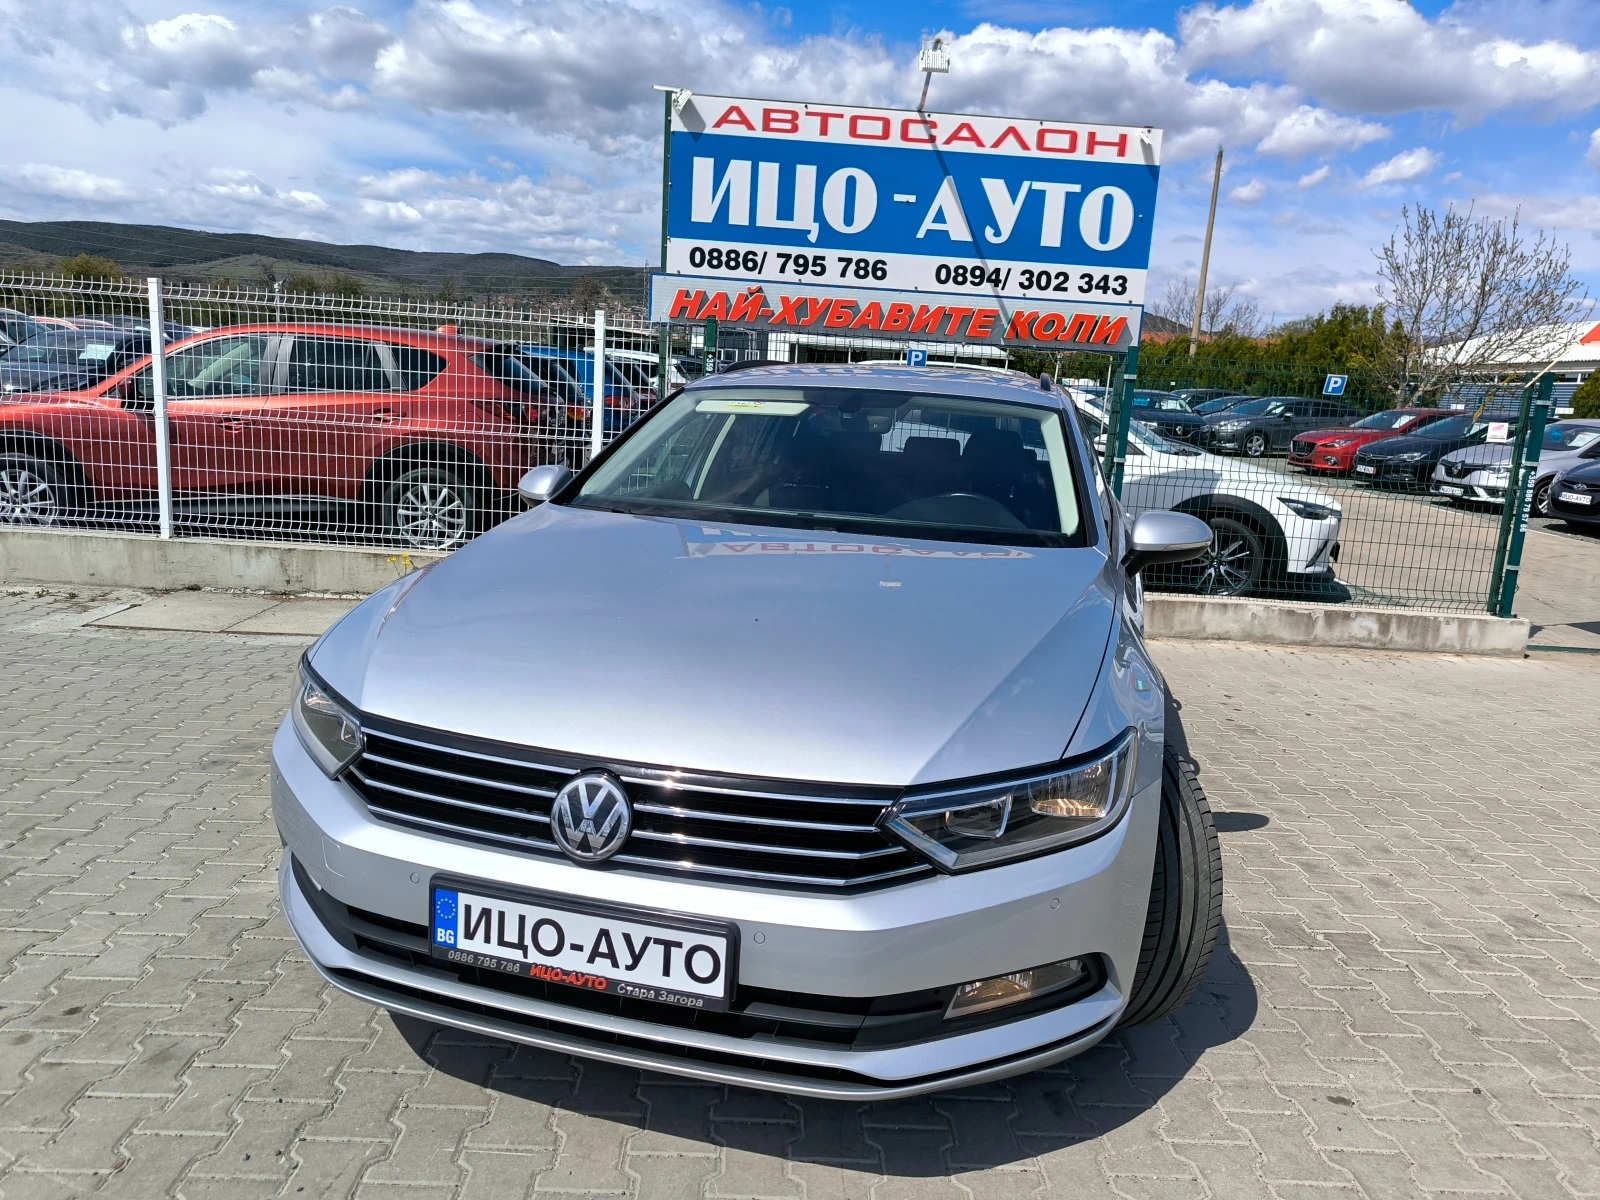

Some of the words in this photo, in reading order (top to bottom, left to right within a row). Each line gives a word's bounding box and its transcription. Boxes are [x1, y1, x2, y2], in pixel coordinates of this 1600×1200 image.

[714, 105, 1129, 158] АВТОСАЛОН
[689, 246, 768, 275] 0886/
[776, 252, 827, 277] 795
[837, 256, 888, 281] 786
[935, 263, 1012, 291] 0894/
[1018, 269, 1070, 292] 302
[1077, 272, 1128, 296] 343
[668, 286, 1000, 339] НАЙ-ХУБАВИТЕ
[1005, 310, 1128, 346] КОЛИ
[910, 350, 923, 367] P
[1327, 377, 1342, 393] P
[1528, 471, 1536, 488] +359
[1525, 489, 1534, 502] 886
[437, 927, 455, 945] BG
[463, 903, 721, 985] ИЦО-АУТО
[448, 950, 475, 964] 0886
[478, 956, 498, 969] 795
[500, 960, 521, 974] 786
[530, 964, 609, 991] ИЦО-АУТО
[617, 983, 656, 999] Стара
[658, 991, 704, 1008] Загора
